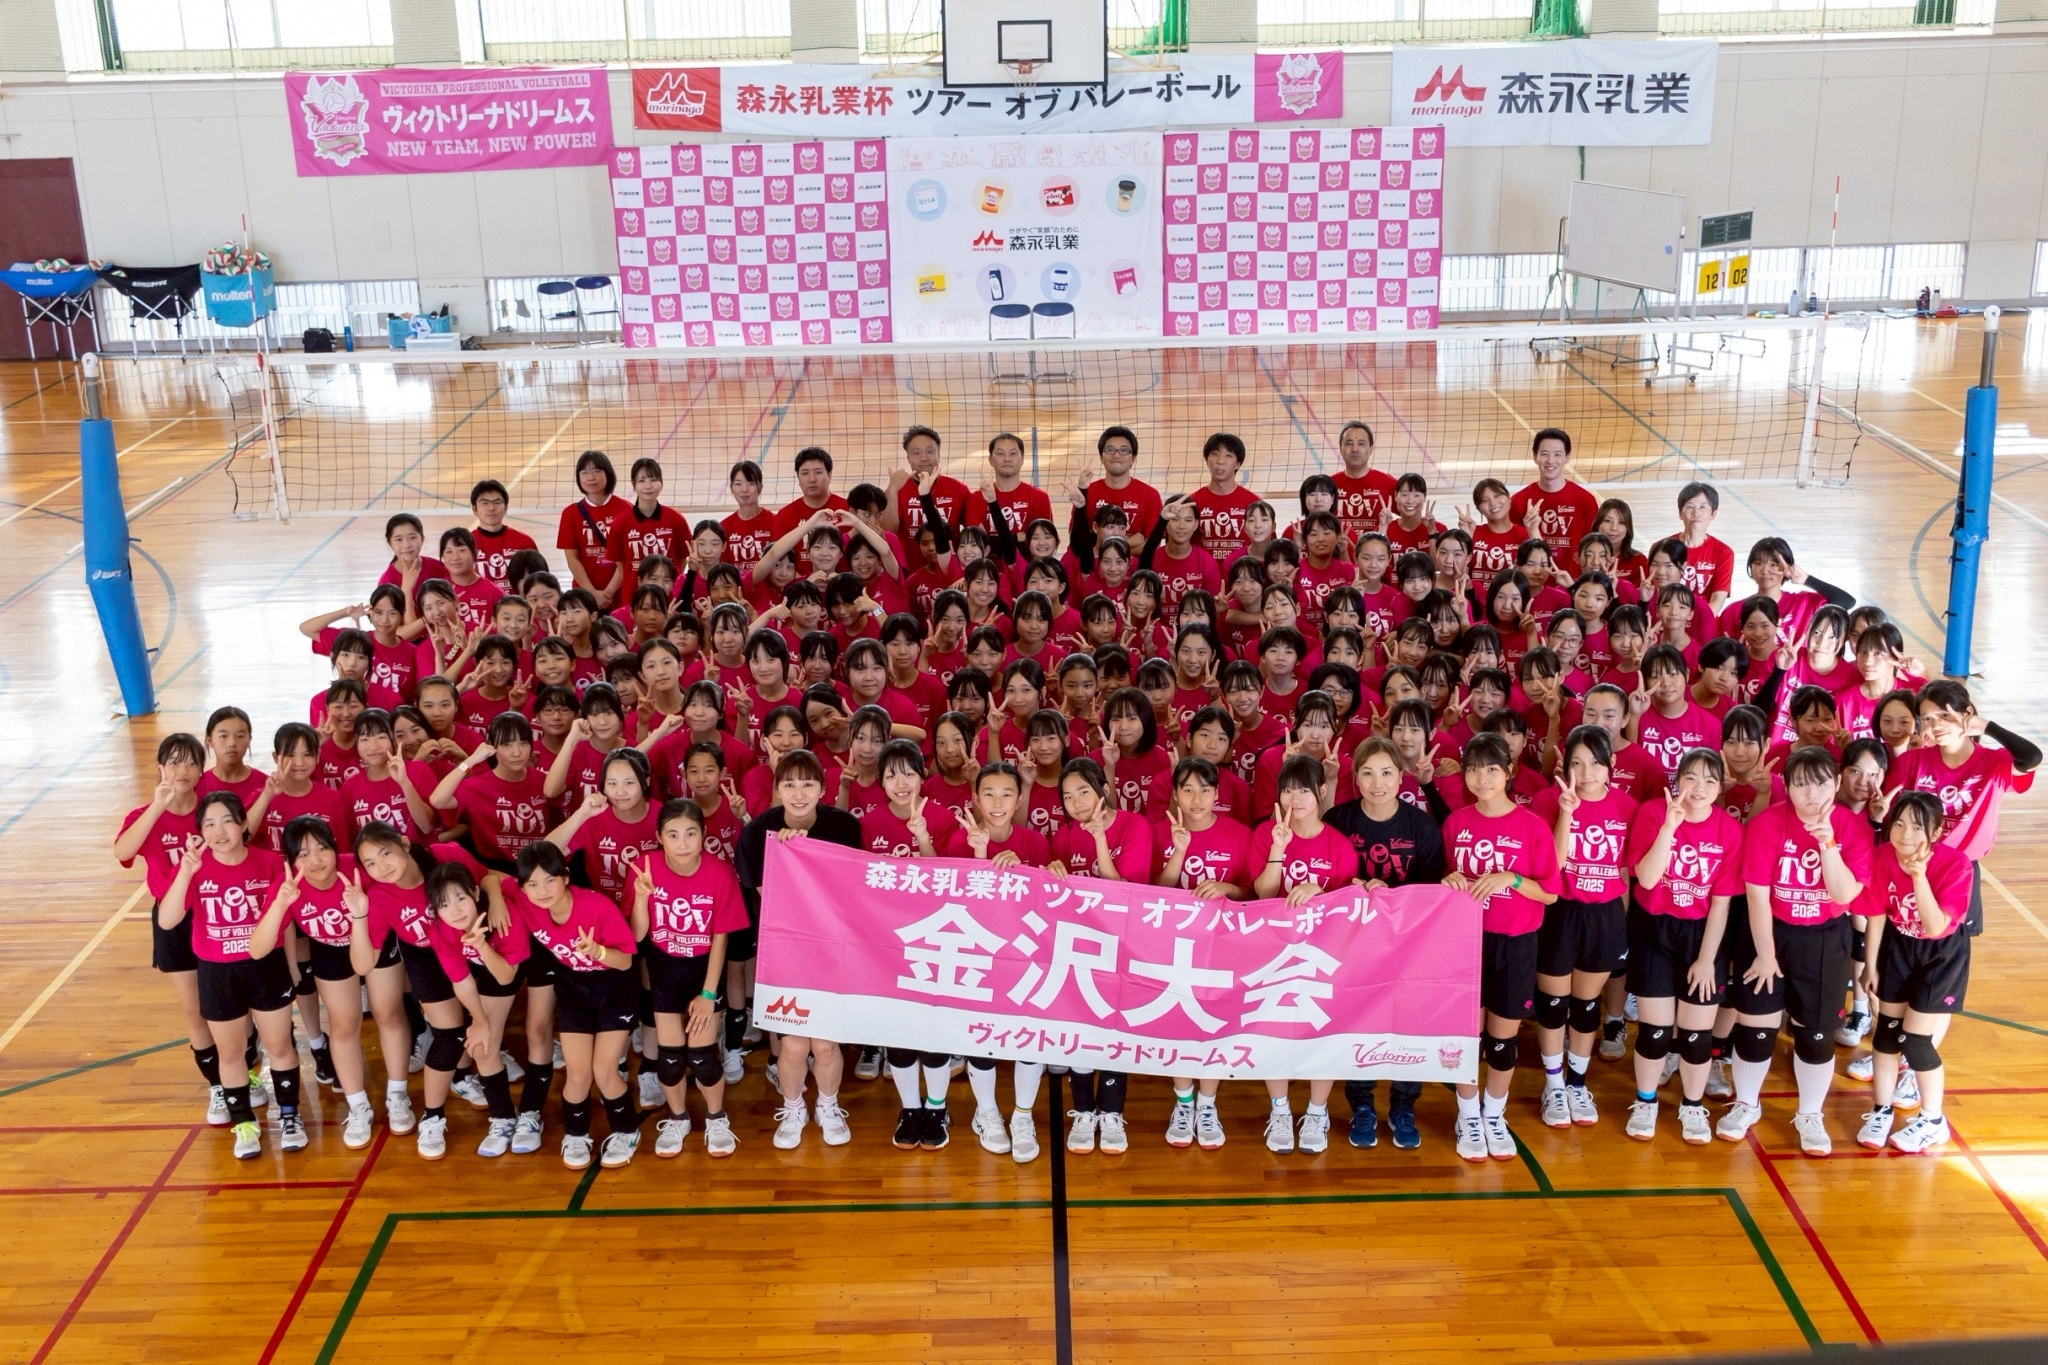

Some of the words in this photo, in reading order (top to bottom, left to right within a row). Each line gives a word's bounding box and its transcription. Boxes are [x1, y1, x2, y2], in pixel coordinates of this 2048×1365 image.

[382, 84, 438, 95] VICTORINA
[442, 79, 518, 93] PROFESSIONAL
[522, 76, 589, 90] VOLLEYBALL
[1497, 72, 1692, 114] 森永乳業
[648, 103, 704, 117] morinaga
[736, 84, 894, 116] 森永乳業杯
[906, 87, 992, 116] ツアー
[1411, 102, 1483, 118] morinaga
[383, 98, 596, 134] ヴィクトリーナドリームス
[387, 140, 429, 157] NEW
[432, 138, 485, 156] TEAM,
[488, 136, 528, 153] NEW
[534, 132, 597, 150] POWER!
[1009, 235, 1080, 250] 森永乳業
[1706, 273, 1719, 290] 12
[1722, 271, 1726, 288] 1
[1733, 268, 1748, 285] 02
[1336, 493, 1379, 517] TOV
[1200, 511, 1245, 538] TOV
[628, 533, 672, 559] TOV
[1643, 737, 1692, 769] TO
[1567, 825, 1626, 863] TOV
[1454, 839, 1518, 877] TOV
[1563, 861, 1578, 873] TOUR
[1578, 866, 1588, 875] OF
[1777, 849, 1822, 886] TO
[864, 861, 1031, 902] 森永乳業杯
[1042, 882, 1129, 915] ツアー
[1576, 878, 1605, 892] 2025
[1775, 888, 1792, 899] TOUR
[1793, 891, 1802, 900] OF
[200, 886, 267, 923] TOV
[654, 897, 713, 932] TOV
[1791, 903, 1820, 918] 2025
[207, 928, 221, 937] TOUR
[222, 928, 230, 937] OF
[301, 908, 353, 938] TO
[653, 930, 667, 940] TOUR
[894, 902, 1343, 1034] 金沢大会
[764, 1013, 809, 1026] morinaga
[967, 1021, 1256, 1069] ヴィクトリーナドリームス
[1353, 1041, 1428, 1064] Victorina
